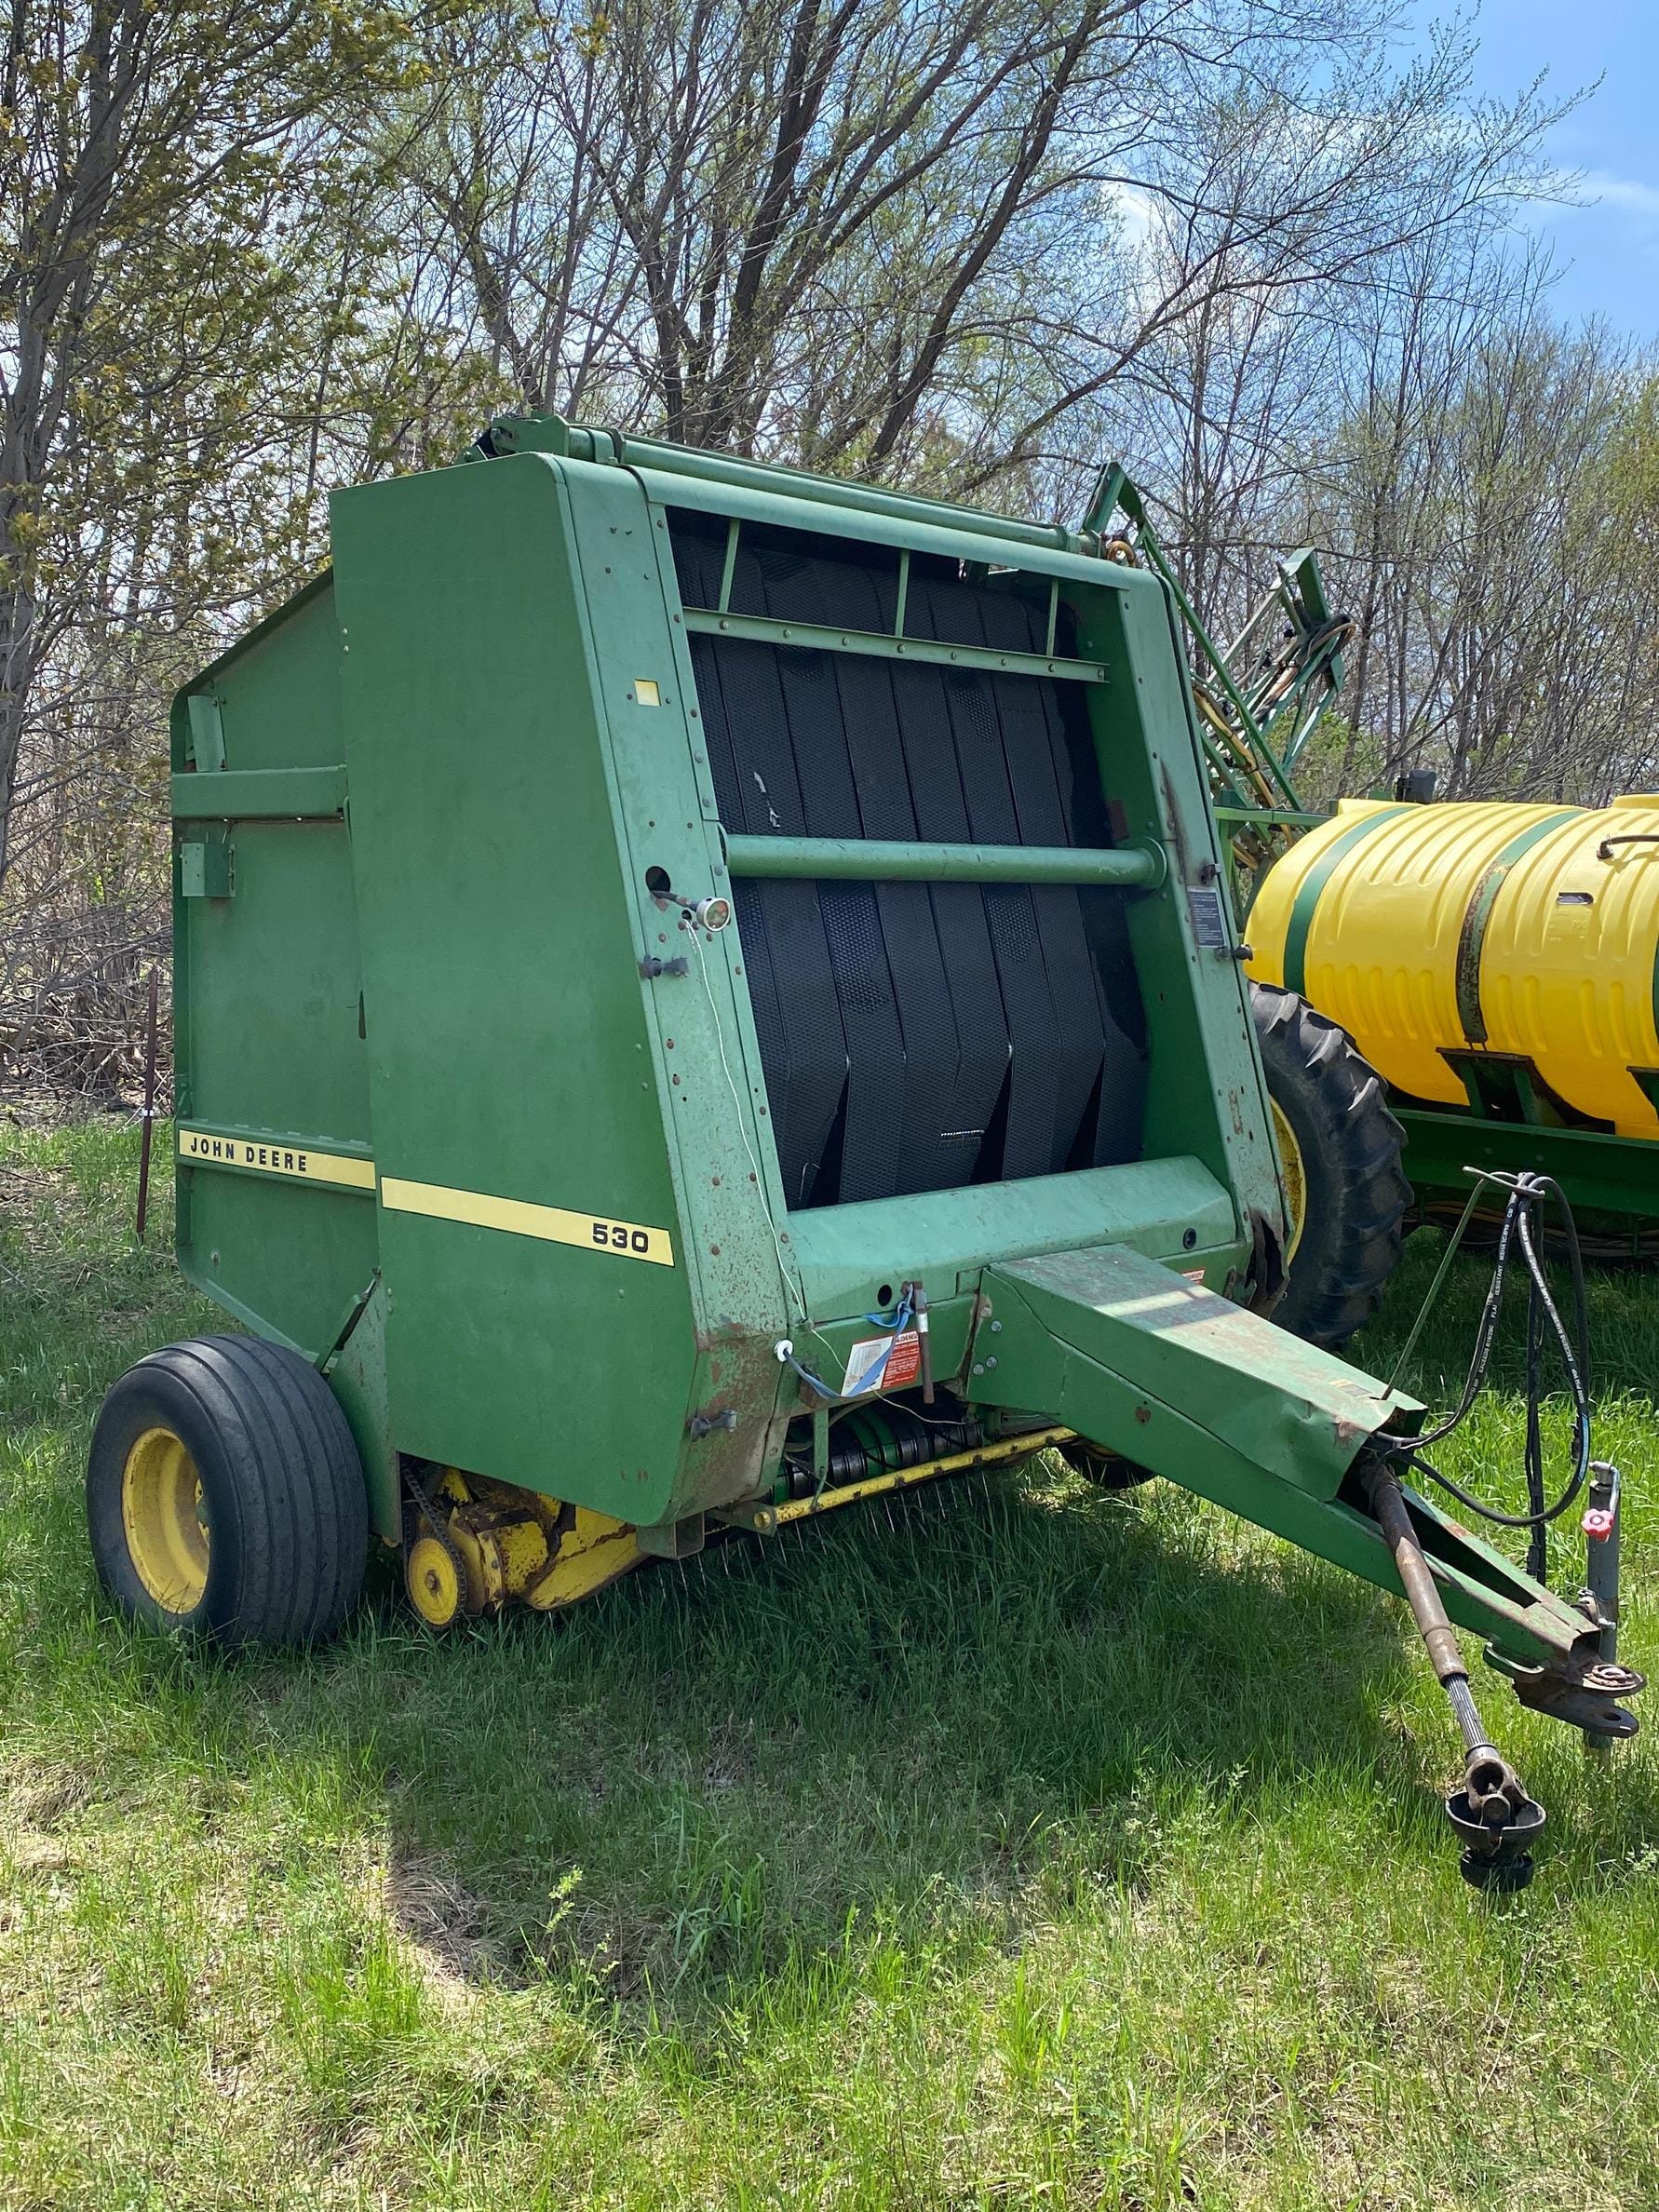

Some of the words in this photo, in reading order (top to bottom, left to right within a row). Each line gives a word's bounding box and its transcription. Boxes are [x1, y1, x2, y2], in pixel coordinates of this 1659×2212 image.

[191, 1137, 234, 1159] JOHN
[246, 1147, 306, 1172] DEERE
[593, 1222, 648, 1253] 530
[1478, 1348, 1490, 1373] EXCEEDS
[1560, 1334, 1573, 1361] EXCEEDS
